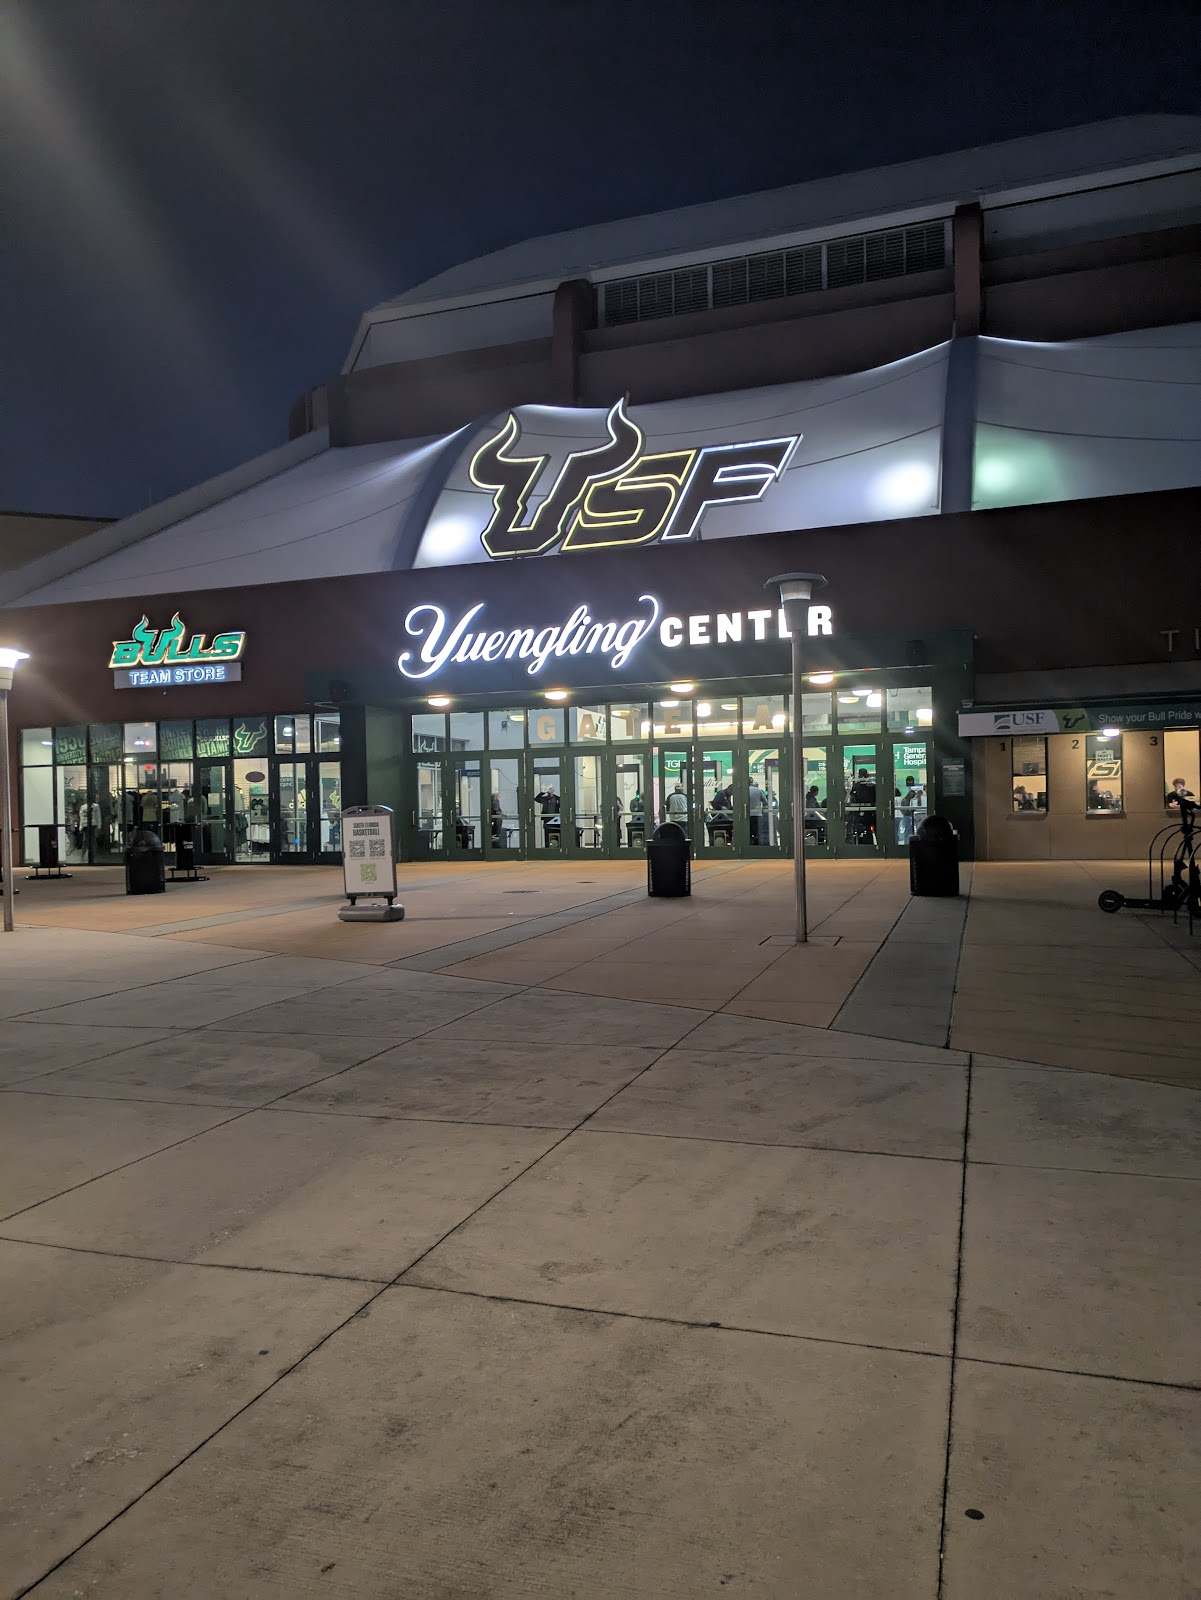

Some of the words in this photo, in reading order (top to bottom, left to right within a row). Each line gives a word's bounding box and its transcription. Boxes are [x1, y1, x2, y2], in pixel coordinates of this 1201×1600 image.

[469, 397, 803, 559] USF
[108, 611, 247, 669] BULLS
[398, 594, 660, 679] Yuengling
[129, 669, 171, 685] TEAM
[174, 666, 225, 683] STORE
[752, 704, 775, 731] A
[1013, 712, 1046, 725] USF
[1098, 713, 1122, 724] Show
[1124, 714, 1147, 724] your
[1148, 711, 1166, 722] Bull
[1168, 709, 1192, 721] Pride
[999, 742, 1006, 752] 1
[1072, 739, 1080, 750] 2
[1150, 736, 1158, 746] 3
